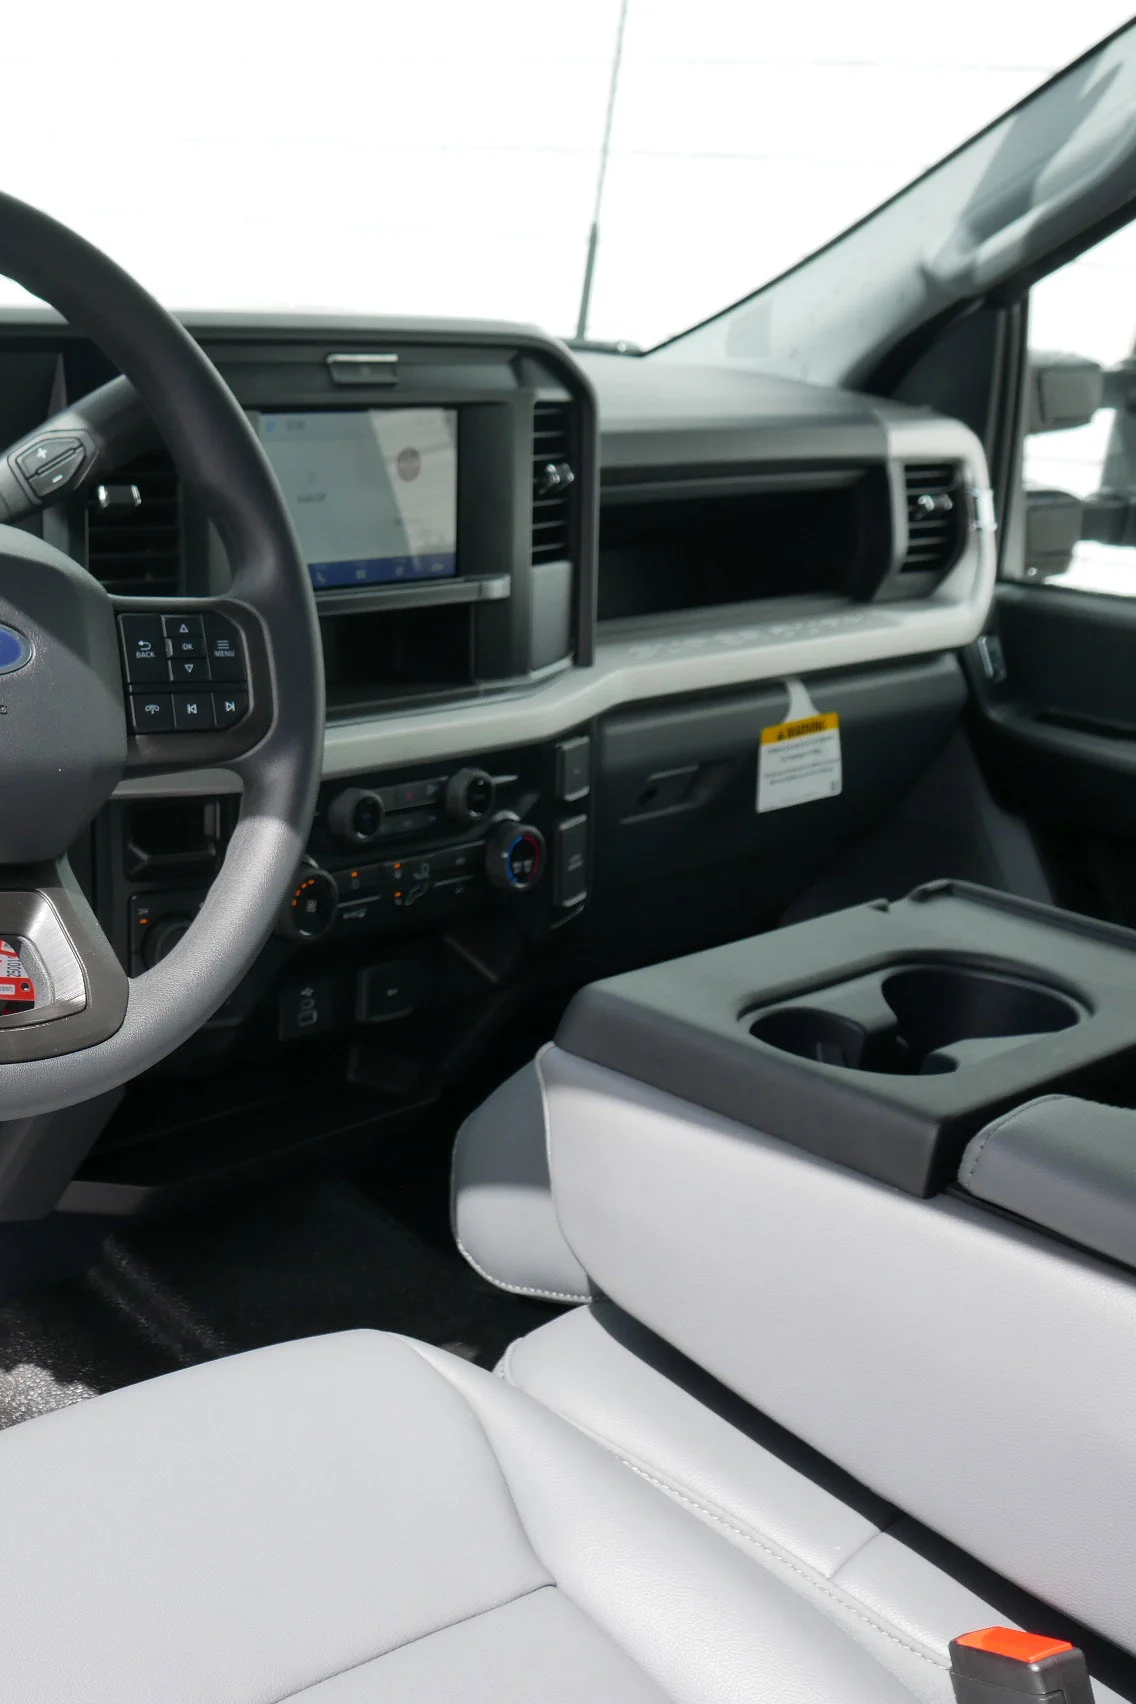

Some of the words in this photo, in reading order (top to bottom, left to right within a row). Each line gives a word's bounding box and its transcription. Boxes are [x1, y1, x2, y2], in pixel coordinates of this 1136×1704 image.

[182, 643, 194, 651] OK
[136, 650, 156, 659] BACK
[214, 650, 235, 658] MENU
